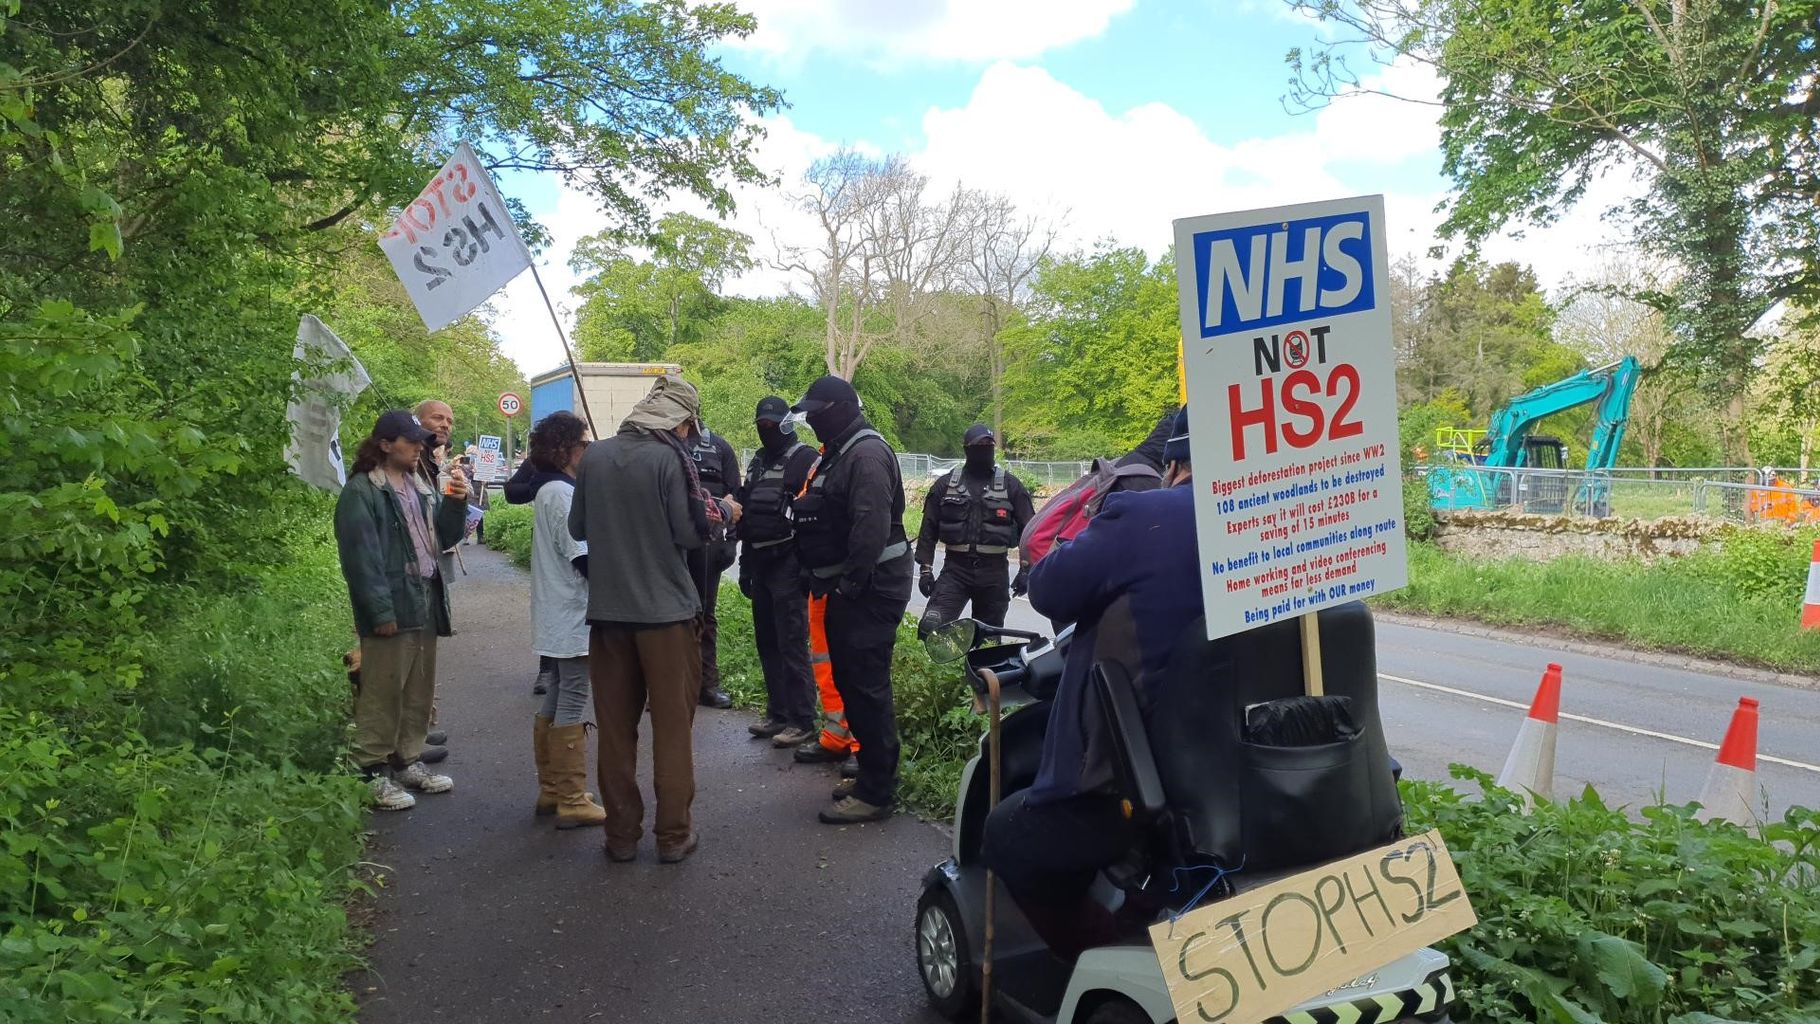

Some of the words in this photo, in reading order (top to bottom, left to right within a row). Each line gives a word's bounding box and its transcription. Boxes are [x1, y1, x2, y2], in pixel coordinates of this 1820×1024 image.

[1205, 221, 1364, 328] NHS
[502, 400, 518, 410] 50
[1228, 363, 1364, 462] HS2
[480, 453, 495, 463] HS2
[481, 438, 498, 449] NHS
[1212, 476, 1245, 496] Biggest
[1248, 462, 1306, 486] deforestation
[1308, 455, 1338, 475] project
[1340, 451, 1360, 465] since
[1363, 444, 1385, 460] WW2
[1217, 499, 1235, 515] 108
[1238, 491, 1270, 510] ancient
[1272, 480, 1318, 501] woodlands
[1320, 479, 1329, 490] to
[1332, 475, 1342, 488] be
[1345, 463, 1385, 484] destroyed
[1227, 516, 1260, 535] Experts
[1262, 513, 1277, 528] say
[1280, 507, 1286, 521] it
[1289, 502, 1305, 519] will
[1308, 499, 1324, 514] cost
[1328, 491, 1355, 510] £230B
[1358, 489, 1370, 502] for
[1373, 489, 1378, 498] a
[1260, 526, 1288, 541] saving
[1291, 519, 1300, 533] of
[1303, 517, 1315, 530] 15
[1318, 511, 1350, 527] minutes
[1212, 561, 1224, 575] No
[1227, 551, 1258, 571] benefit
[1261, 550, 1270, 562] to
[1273, 541, 1293, 559] local
[1296, 530, 1347, 553] communities
[1350, 525, 1373, 539] along
[1375, 518, 1396, 533] route
[1226, 578, 1251, 592] Home
[1254, 566, 1289, 585] working
[1291, 558, 1307, 575] and
[1310, 553, 1333, 570] video
[1336, 540, 1387, 563] conferencing
[1244, 607, 1269, 623] Being
[1272, 598, 1291, 619] paid
[1293, 596, 1305, 609] for
[1308, 589, 1326, 605] with
[1329, 584, 1347, 600] OUR
[1349, 578, 1375, 595] money
[1261, 582, 1288, 597] means
[1291, 576, 1303, 590] far
[1306, 573, 1322, 585] less
[1325, 560, 1357, 580] demand
